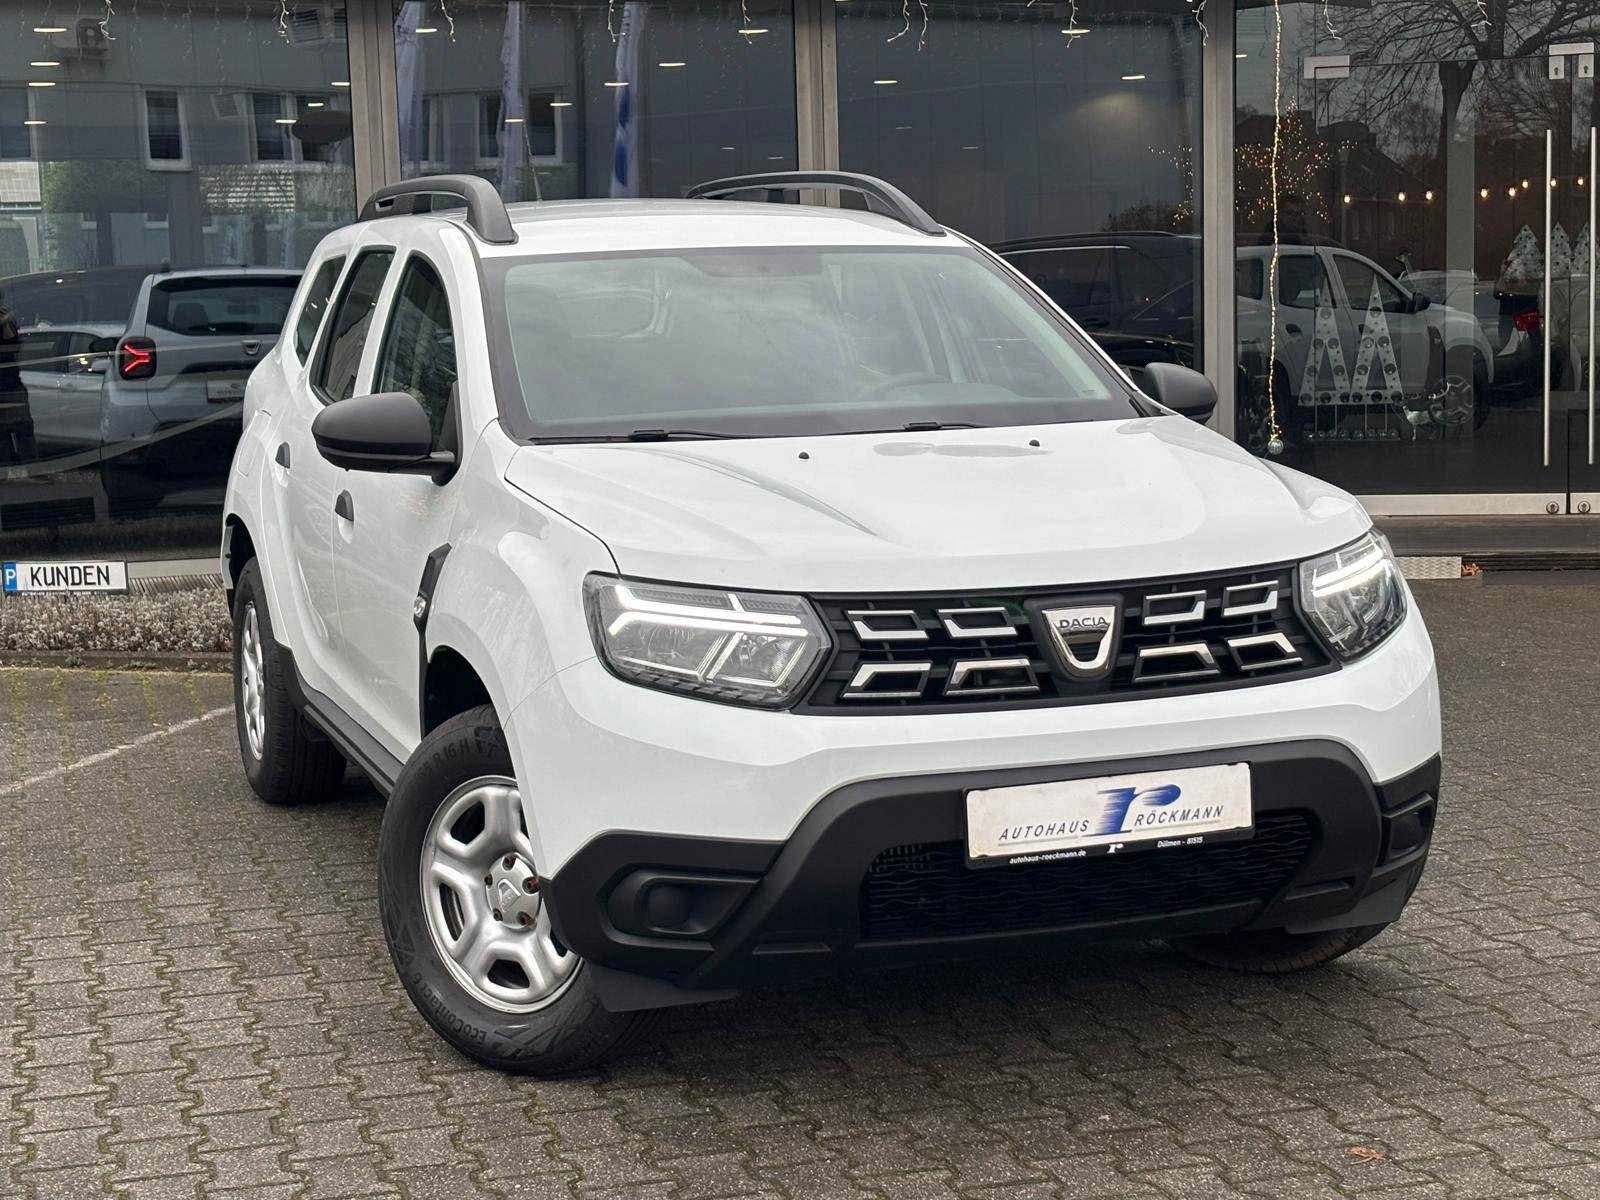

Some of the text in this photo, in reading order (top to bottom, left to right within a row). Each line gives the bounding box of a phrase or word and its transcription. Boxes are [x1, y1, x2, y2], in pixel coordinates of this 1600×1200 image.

[6, 565, 111, 587] P KUNDEN
[1058, 616, 1108, 629] DACIA
[998, 819, 1090, 841] AUTOHAUS
[1134, 805, 1224, 826] RÖCKMANN
[1009, 849, 1087, 865] autohaus-roeckmann.de
[1157, 840, 1181, 848] Dülmen
